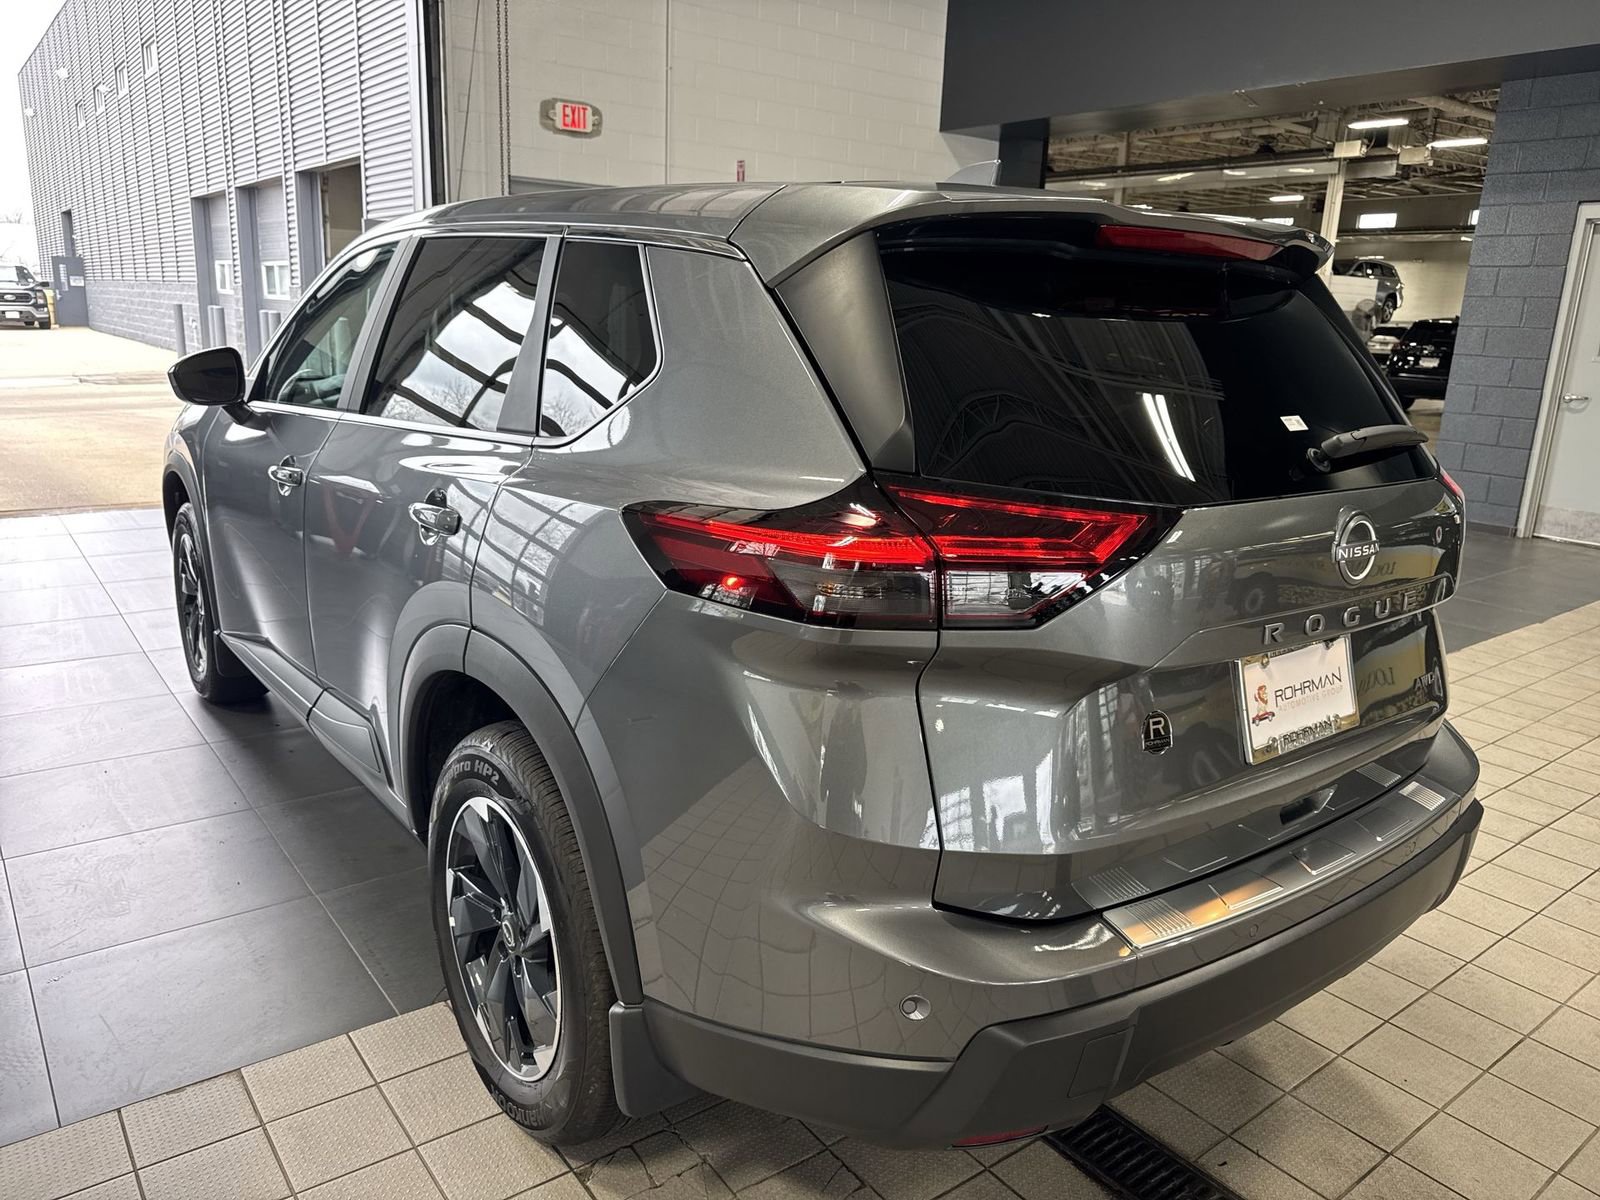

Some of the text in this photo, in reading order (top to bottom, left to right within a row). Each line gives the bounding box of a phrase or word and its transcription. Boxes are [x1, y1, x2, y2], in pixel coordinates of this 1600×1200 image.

[562, 104, 588, 129] EXIT
[1338, 543, 1379, 559] NISSAN
[1264, 590, 1417, 645] ROGUE
[1275, 666, 1341, 708] ROHRMAN
[1414, 672, 1434, 692] AWD
[1150, 717, 1165, 740] R
[1283, 715, 1332, 745] ROHRMAN
[474, 760, 500, 786] HP2
